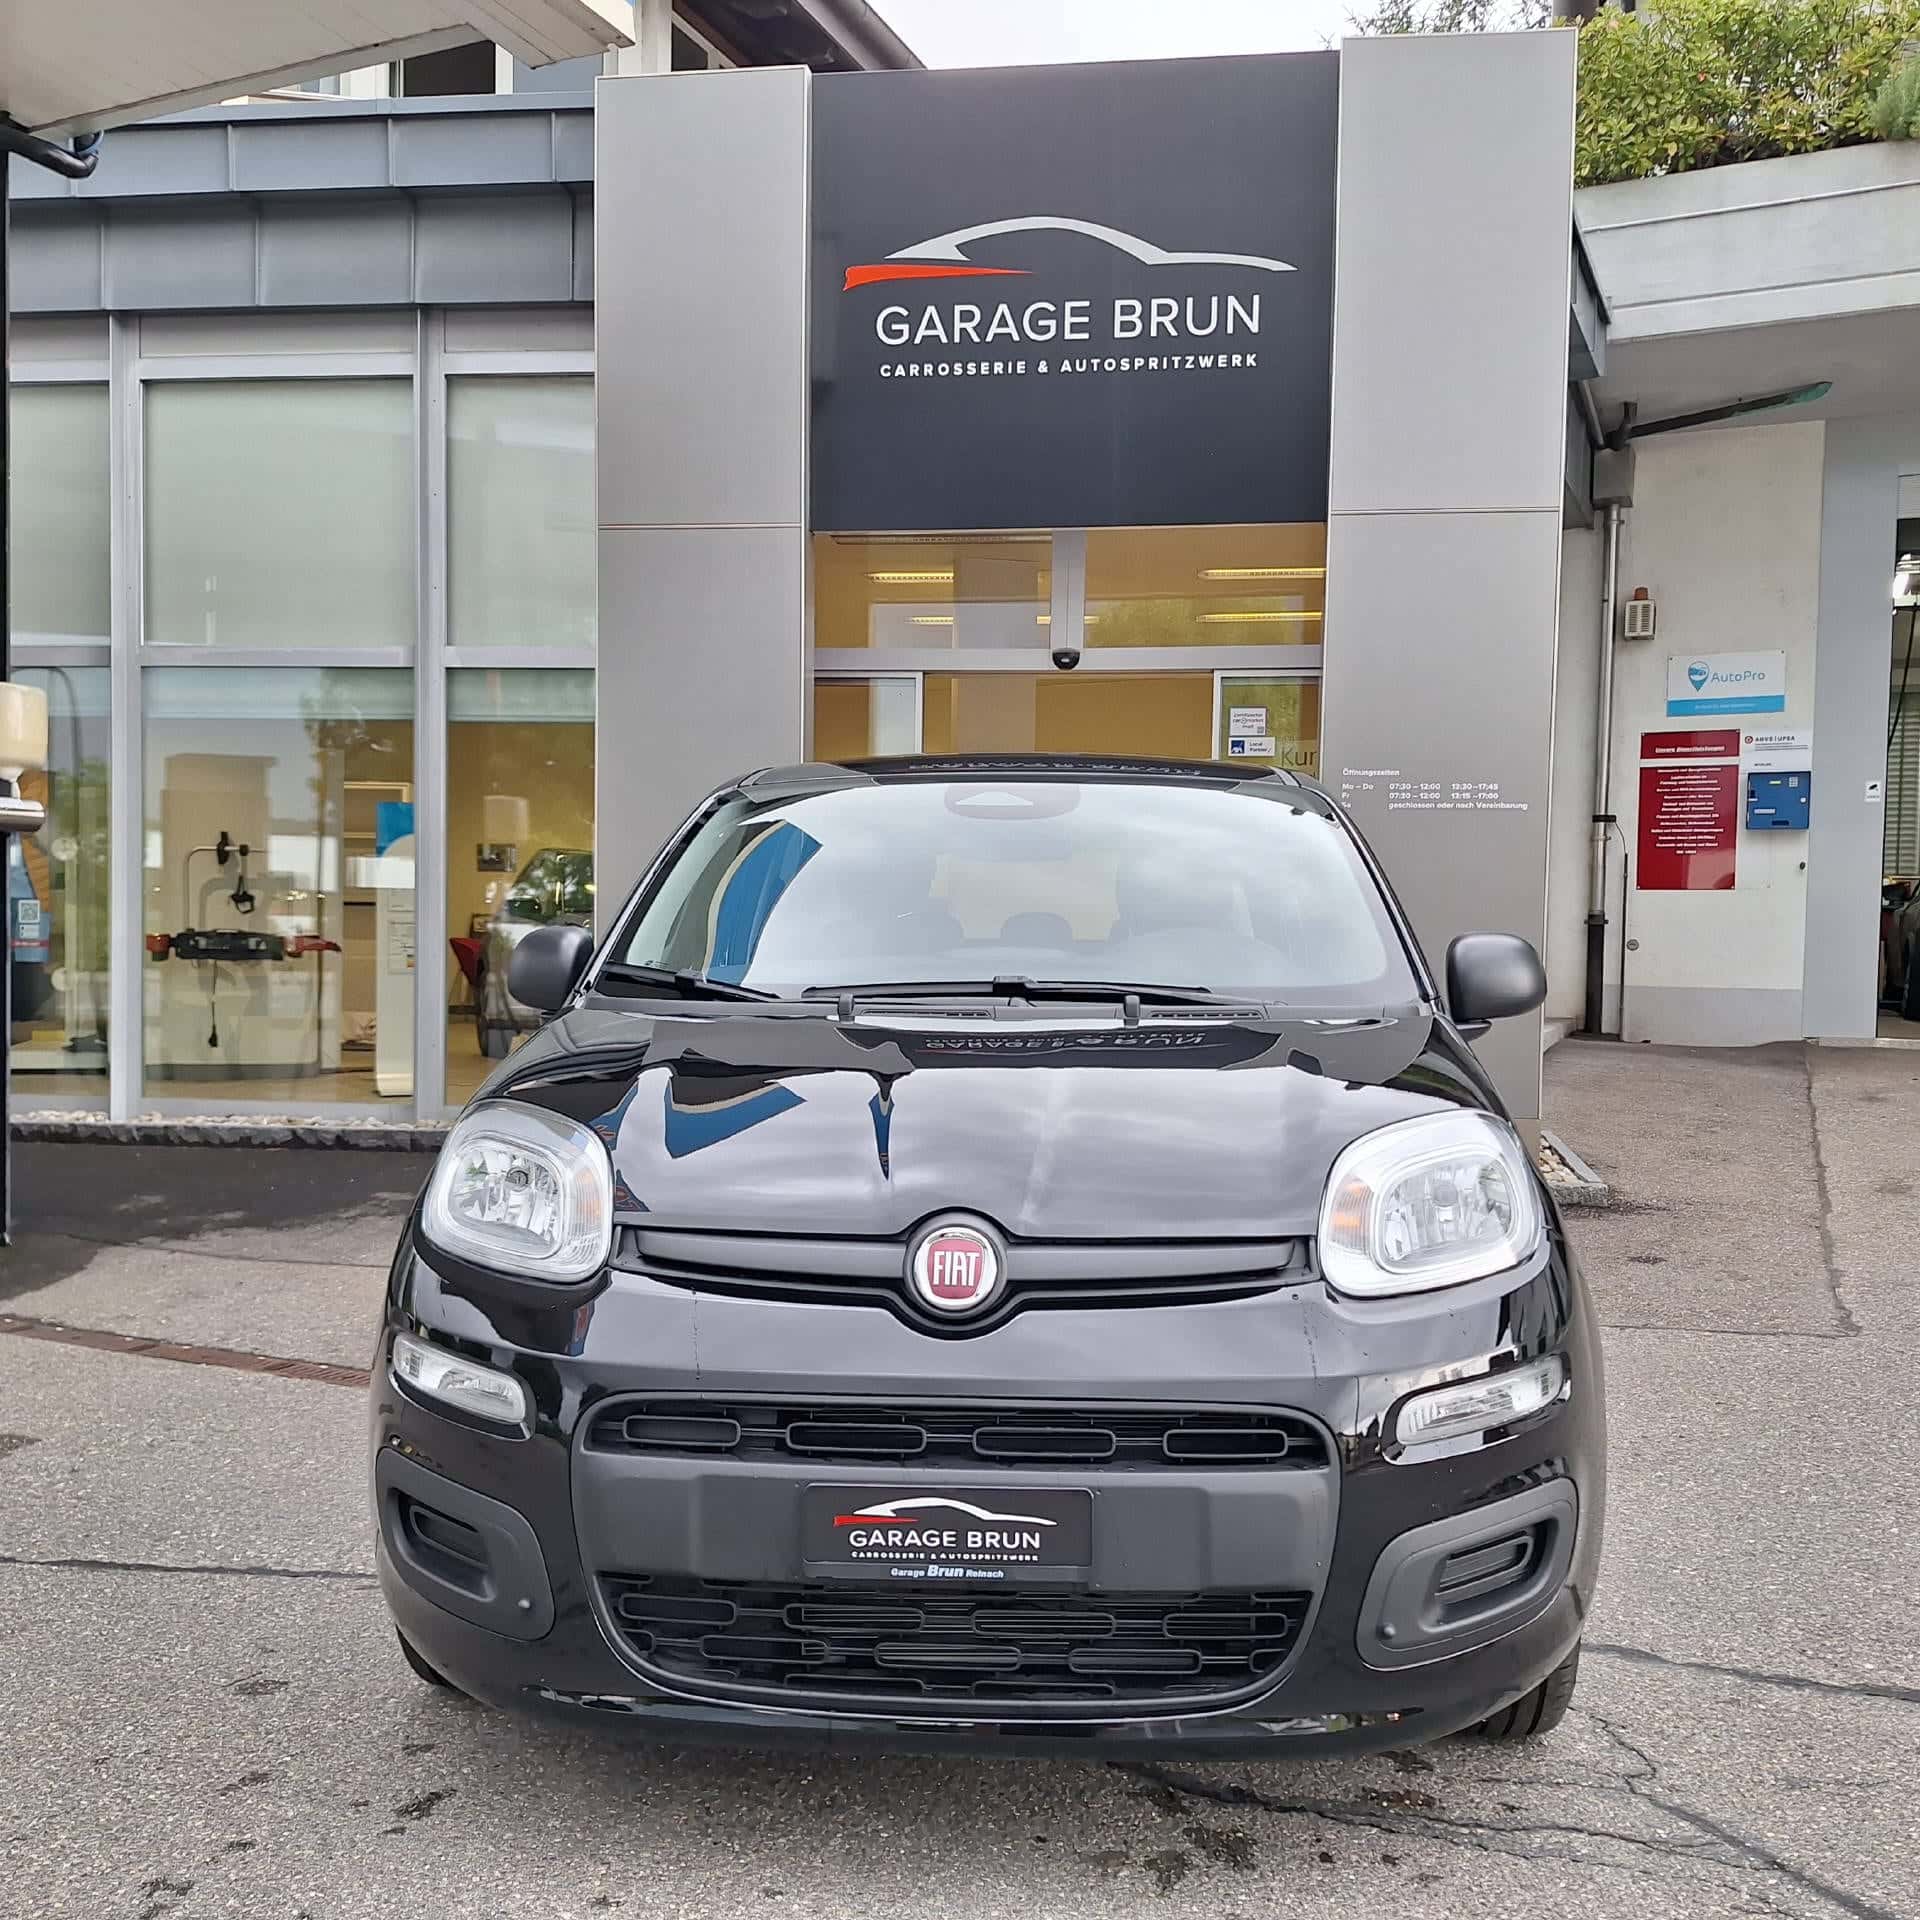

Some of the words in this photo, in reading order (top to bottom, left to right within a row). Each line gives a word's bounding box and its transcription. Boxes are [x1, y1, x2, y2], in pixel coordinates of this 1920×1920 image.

[876, 300, 1091, 346] GARAGE
[1113, 294, 1261, 339] BRUN
[879, 360, 1027, 378] CARROSSERIE
[1037, 360, 1049, 374] &
[1060, 353, 1258, 374] AUTOSPRITZWERK
[1711, 670, 1766, 683] AutoPro
[1342, 767, 1400, 777] Öffnungszeiten
[1342, 783, 1354, 791] Mo
[1363, 783, 1374, 791] Do
[1389, 801, 1435, 810] geschlossen
[933, 1250, 980, 1287] FIAT
[848, 1529, 957, 1548] GARAGE
[967, 1531, 1041, 1549] BRUN
[851, 1551, 925, 1560] CARROSSERIE
[940, 1551, 1039, 1561] AUTOSPRITZWERK
[890, 1567, 925, 1578] Garage
[927, 1564, 964, 1578] Brun
[966, 1569, 1004, 1579] Reinach
